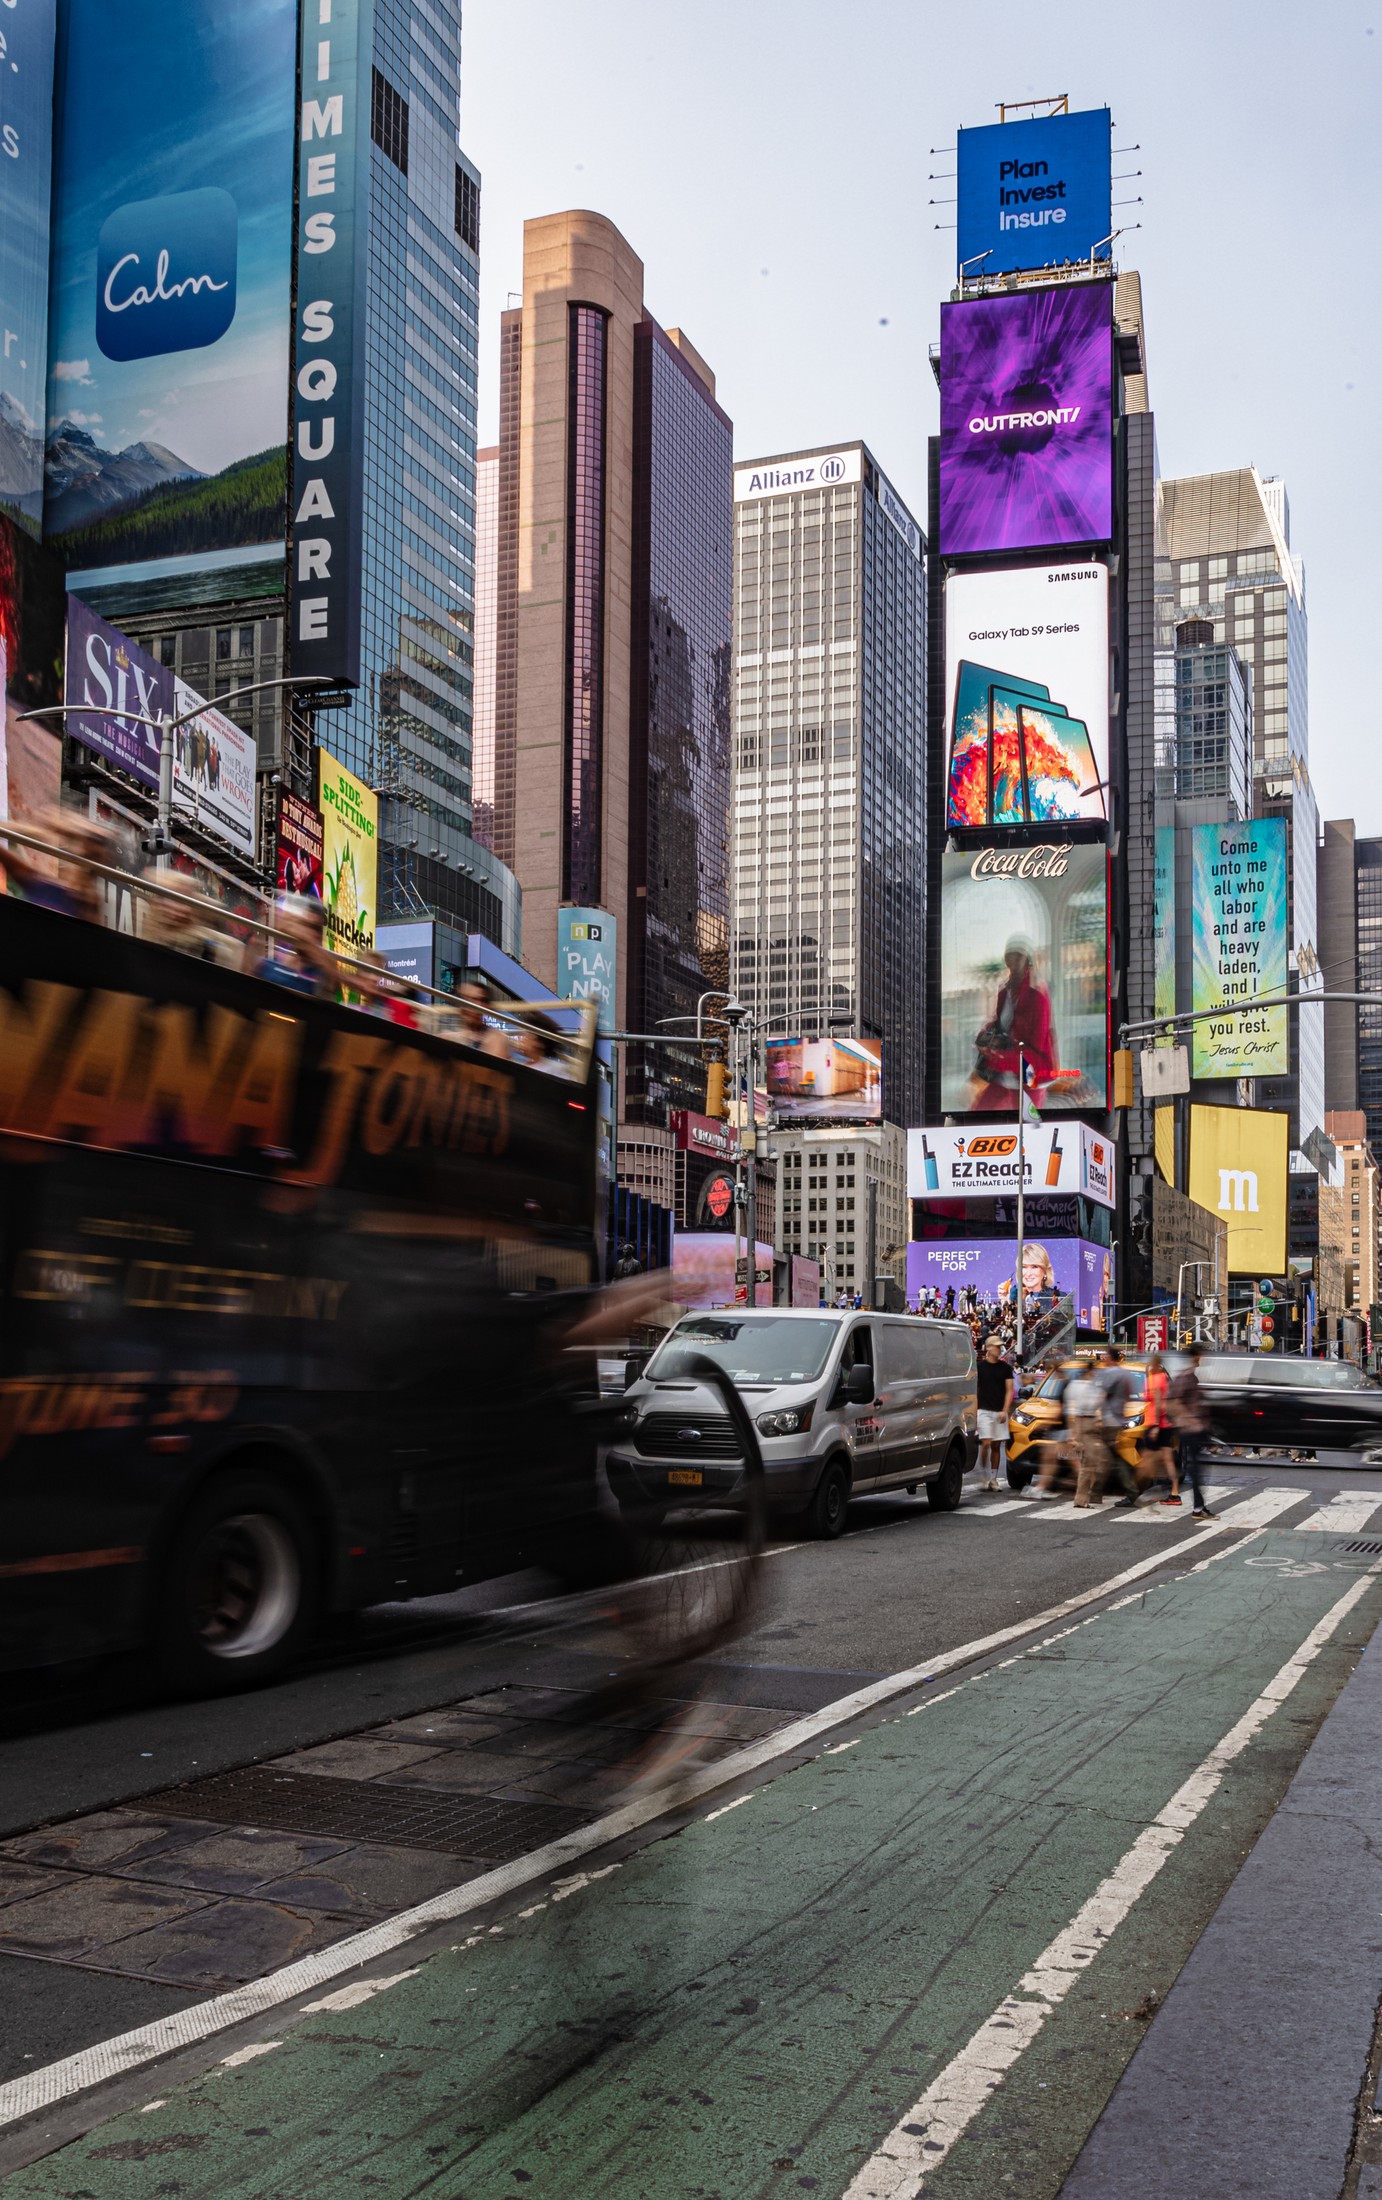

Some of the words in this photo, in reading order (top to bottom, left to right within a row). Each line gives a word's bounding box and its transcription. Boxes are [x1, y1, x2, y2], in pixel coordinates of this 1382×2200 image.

[1000, 159, 1048, 181] Plan
[1000, 180, 1066, 206] Invest
[1000, 207, 1067, 231] Insure
[104, 249, 228, 313] Calm
[295, 300, 338, 641] SQUARE
[749, 468, 815, 492] Allianz
[884, 489, 907, 536] Allianz
[1047, 570, 1098, 583] SAMSUNG
[968, 629, 1008, 641] Galaxy
[1009, 627, 1030, 637] Tab
[1031, 626, 1044, 635] S9
[1045, 623, 1080, 634] Series
[84, 633, 162, 755] SIX
[104, 721, 115, 740] THE
[118, 731, 145, 760] MUSICAL
[224, 752, 235, 767] THE
[235, 756, 251, 777] PLAY
[221, 762, 235, 779] THAT
[235, 772, 254, 796] GOES
[221, 774, 253, 814] WRONG
[1221, 840, 1258, 856] Come
[970, 843, 1074, 882] Coca-Cola
[1211, 861, 1241, 876] unto
[1247, 860, 1267, 873] me
[1214, 879, 1232, 896] all
[1237, 878, 1265, 893] who
[1222, 899, 1258, 915] labor
[574, 926, 608, 941] npr
[1213, 919, 1238, 936] and
[1244, 920, 1266, 933] are
[1220, 940, 1260, 957] heavy
[388, 958, 417, 968] Montréal
[1218, 959, 1261, 975] laden,
[1222, 978, 1247, 994] and
[1253, 977, 1257, 993] I
[1210, 1023, 1233, 1039] you
[1239, 1018, 1270, 1034] rest.
[1209, 1043, 1241, 1057] Jesus
[1243, 1041, 1279, 1055] Christ
[1049, 1068, 1081, 1078] BURNS
[952, 1162, 973, 1178] EZ
[976, 1161, 1033, 1178] Reach
[952, 1180, 966, 1188] THE
[967, 1179, 1001, 1187] ULTIMATE
[1217, 1168, 1260, 1212] m
[927, 1250, 982, 1262] PERFECT
[941, 1262, 967, 1271] FOR
[1145, 1319, 1163, 1353] tkts
